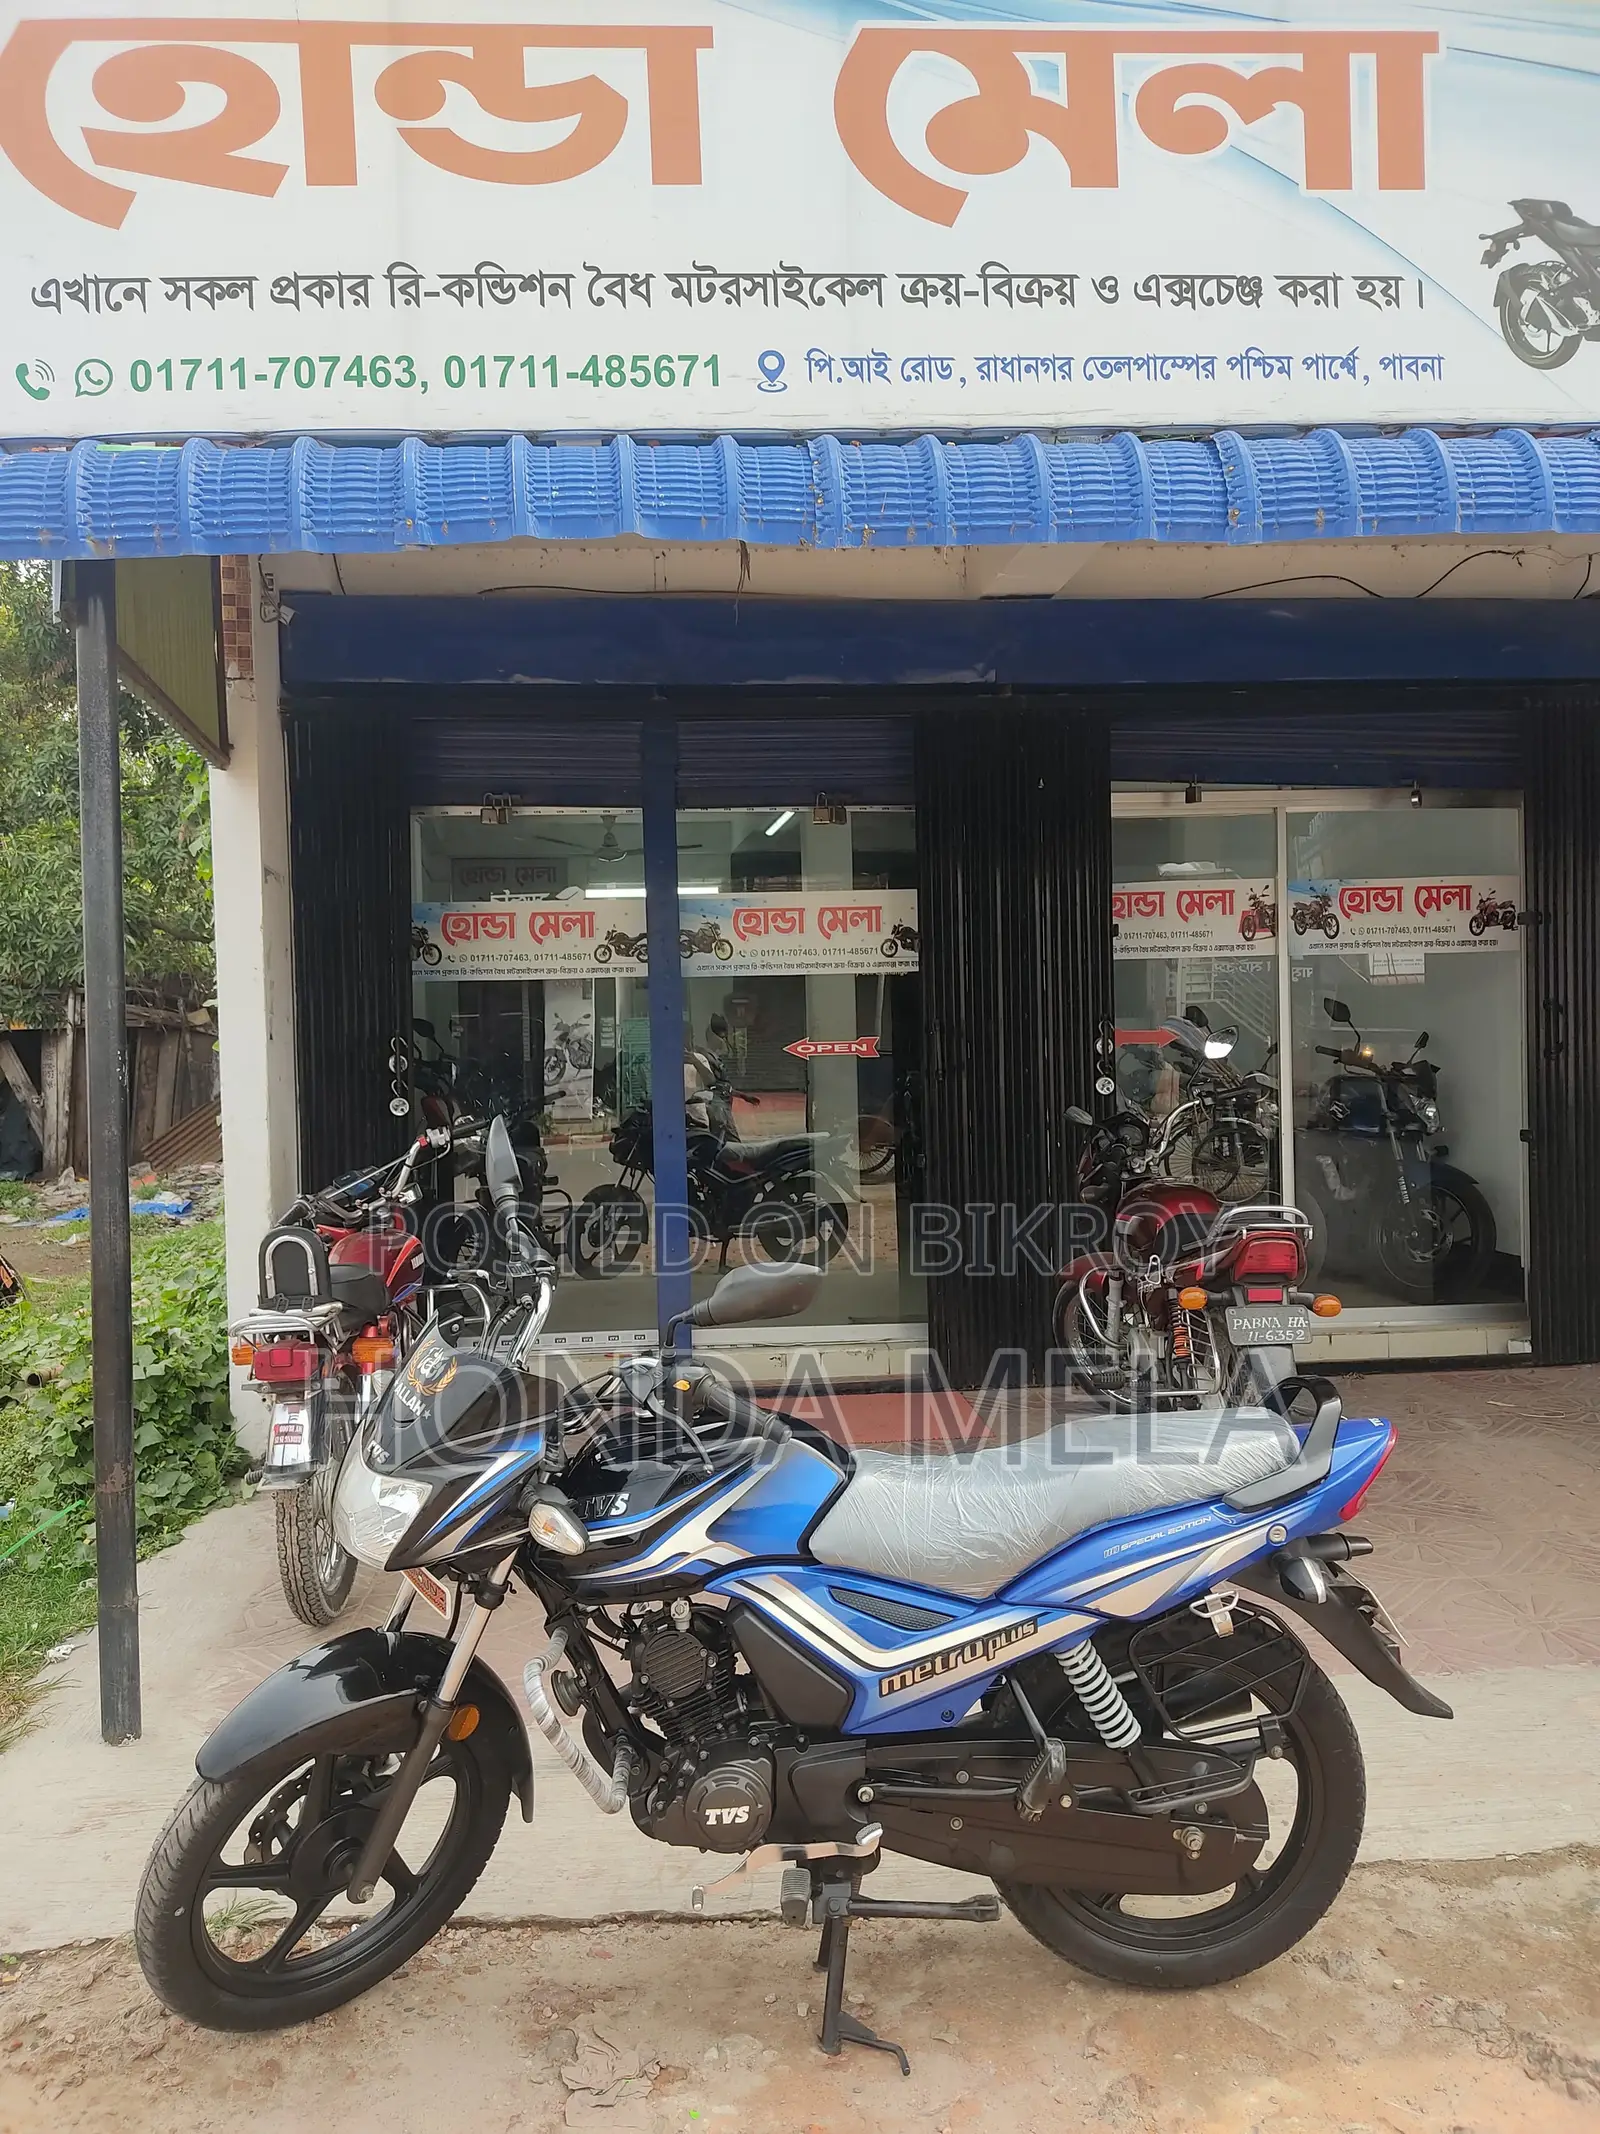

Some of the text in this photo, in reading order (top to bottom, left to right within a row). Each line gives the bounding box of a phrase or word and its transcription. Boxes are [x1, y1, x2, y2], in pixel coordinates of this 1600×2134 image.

[0, 17, 1440, 230] হোন্ডা মেলা
[32, 273, 151, 314] এখানে
[159, 275, 259, 311] সকল
[271, 271, 373, 312] প্রকার
[382, 261, 576, 309] রি-কন্ডিশন
[584, 262, 655, 309] বৈধ
[664, 260, 887, 310] মটরসাইকেল
[1091, 275, 1119, 305] ও
[1134, 273, 1263, 310] এক্সচেঞ্জ
[1273, 272, 1344, 309] করা
[129, 354, 720, 394] 01711-707463, 01711-485671
[804, 347, 891, 384] পি.আই
[974, 354, 1074, 384] রাধানগর
[1083, 353, 1217, 381] তেলপাম্পের
[1226, 346, 1294, 381] পশ্চিম
[1379, 353, 1445, 381] পাবনা
[1176, 889, 1235, 923] মেলা
[1339, 885, 1472, 919] হোন্ডা মেলা
[441, 911, 596, 946] হোন্ডা মেলা
[732, 906, 882, 941] হোন্ডা মেলা
[1171, 930, 1213, 939] 01711-485671
[1413, 925, 1456, 934] 01711-485671
[533, 952, 592, 962] 01711-485671
[822, 947, 878, 957] 01711-485671
[796, 1043, 867, 1053] OPEN
[1232, 1316, 1281, 1331] PABNA
[1247, 1329, 1305, 1342] 11-6352
[394, 1382, 426, 1416] ALLAH
[1120, 1531, 1167, 1552] SPECIAL
[1167, 1515, 1212, 1535] EDITION
[987, 1621, 1036, 1662] plus
[705, 1805, 750, 1825] TVS
